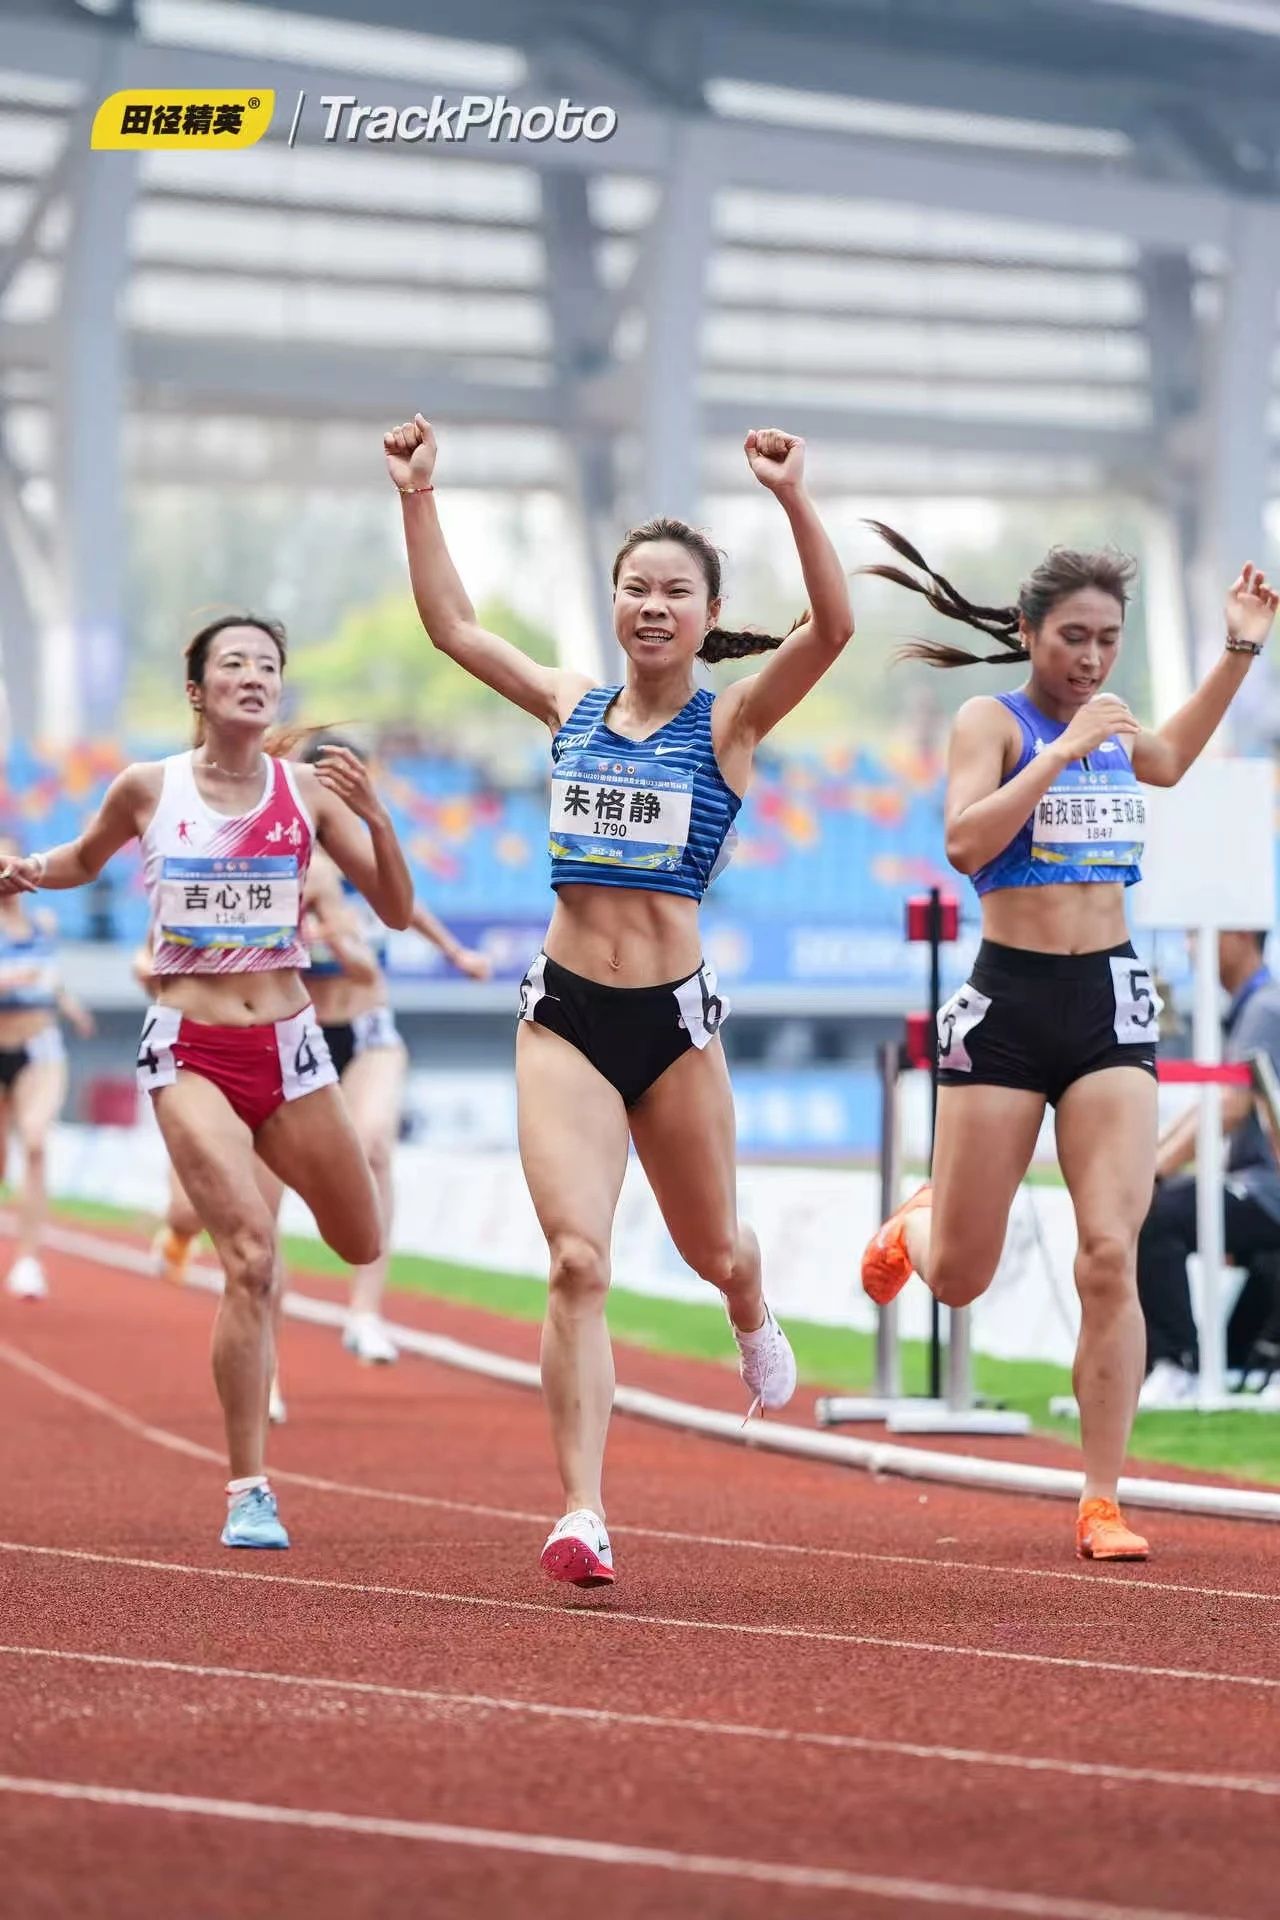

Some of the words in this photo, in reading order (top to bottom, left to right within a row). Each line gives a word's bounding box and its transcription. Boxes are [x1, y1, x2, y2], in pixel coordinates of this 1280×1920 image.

[563, 784, 661, 824] 朱格静
[592, 821, 627, 838] 1790
[1087, 827, 1113, 840] 1847
[184, 884, 272, 911] 吉心悦
[700, 970, 722, 1035] 6
[1129, 969, 1156, 1028] 5
[136, 1017, 159, 1075] 4
[294, 1025, 319, 1076] 4
